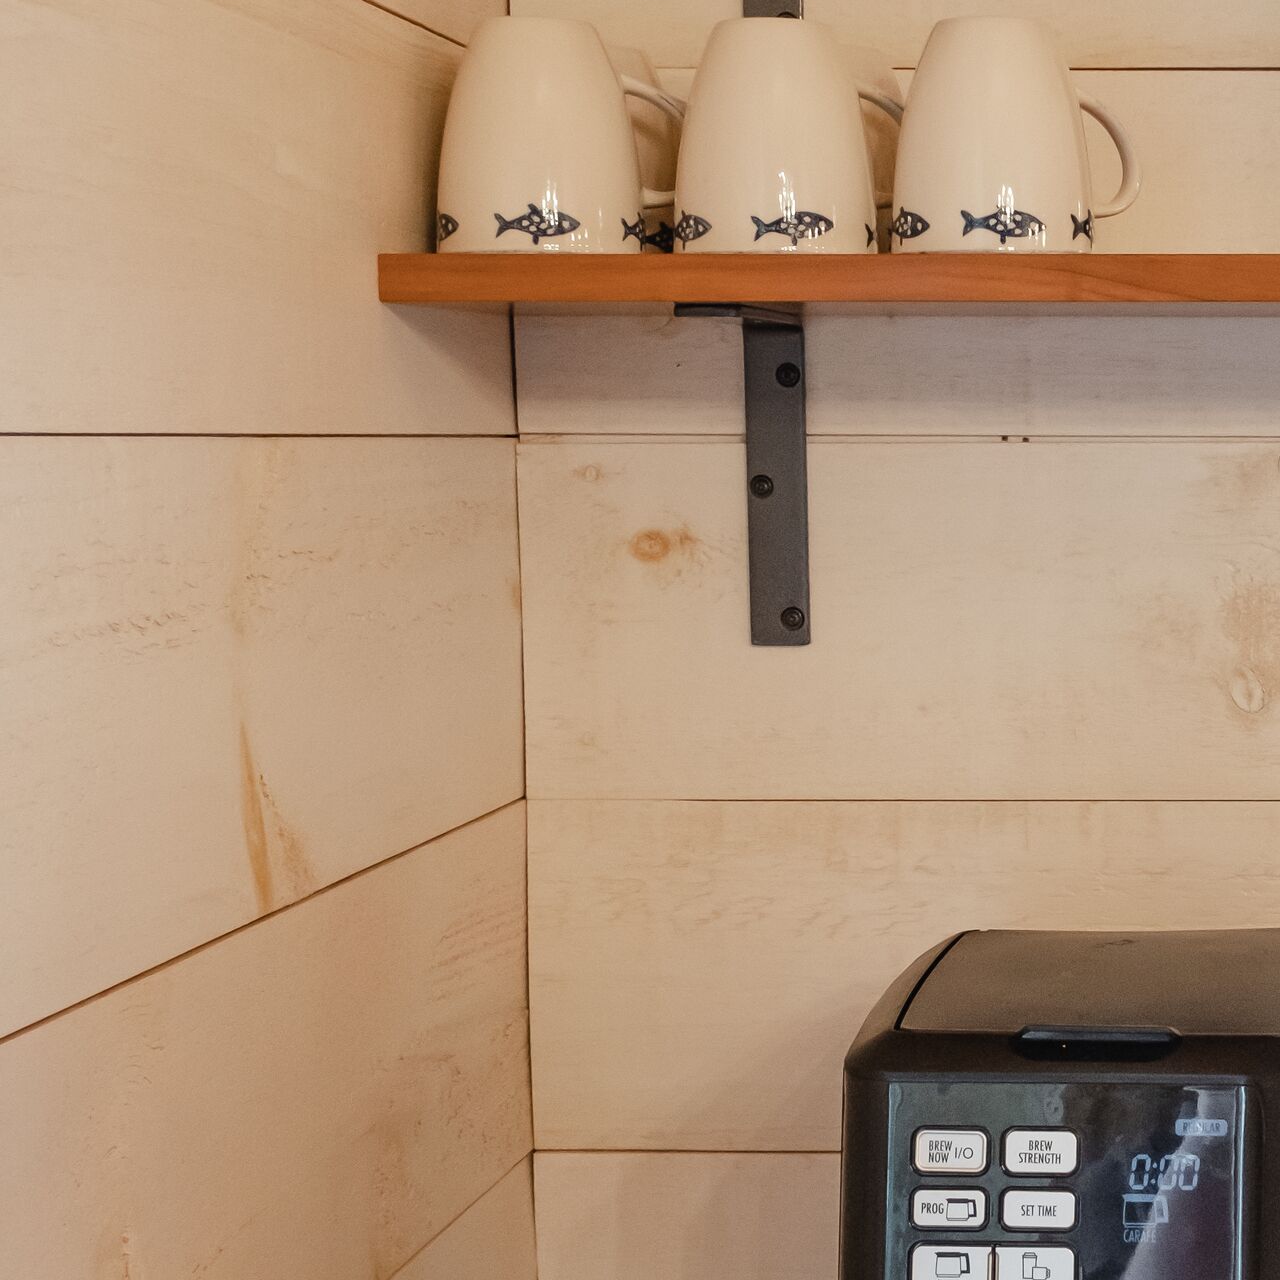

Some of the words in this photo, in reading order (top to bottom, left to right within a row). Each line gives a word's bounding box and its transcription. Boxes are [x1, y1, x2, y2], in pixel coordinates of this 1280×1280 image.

[928, 1140, 953, 1151] BREW
[1028, 1140, 1053, 1151] BREW
[928, 1152, 949, 1163] NOW
[1018, 1152, 1062, 1164] STRENGTH
[1128, 1153, 1201, 1191] 0:00
[921, 1202, 945, 1215] PROG
[1021, 1204, 1034, 1217] SET
[1038, 1205, 1057, 1218] TIME
